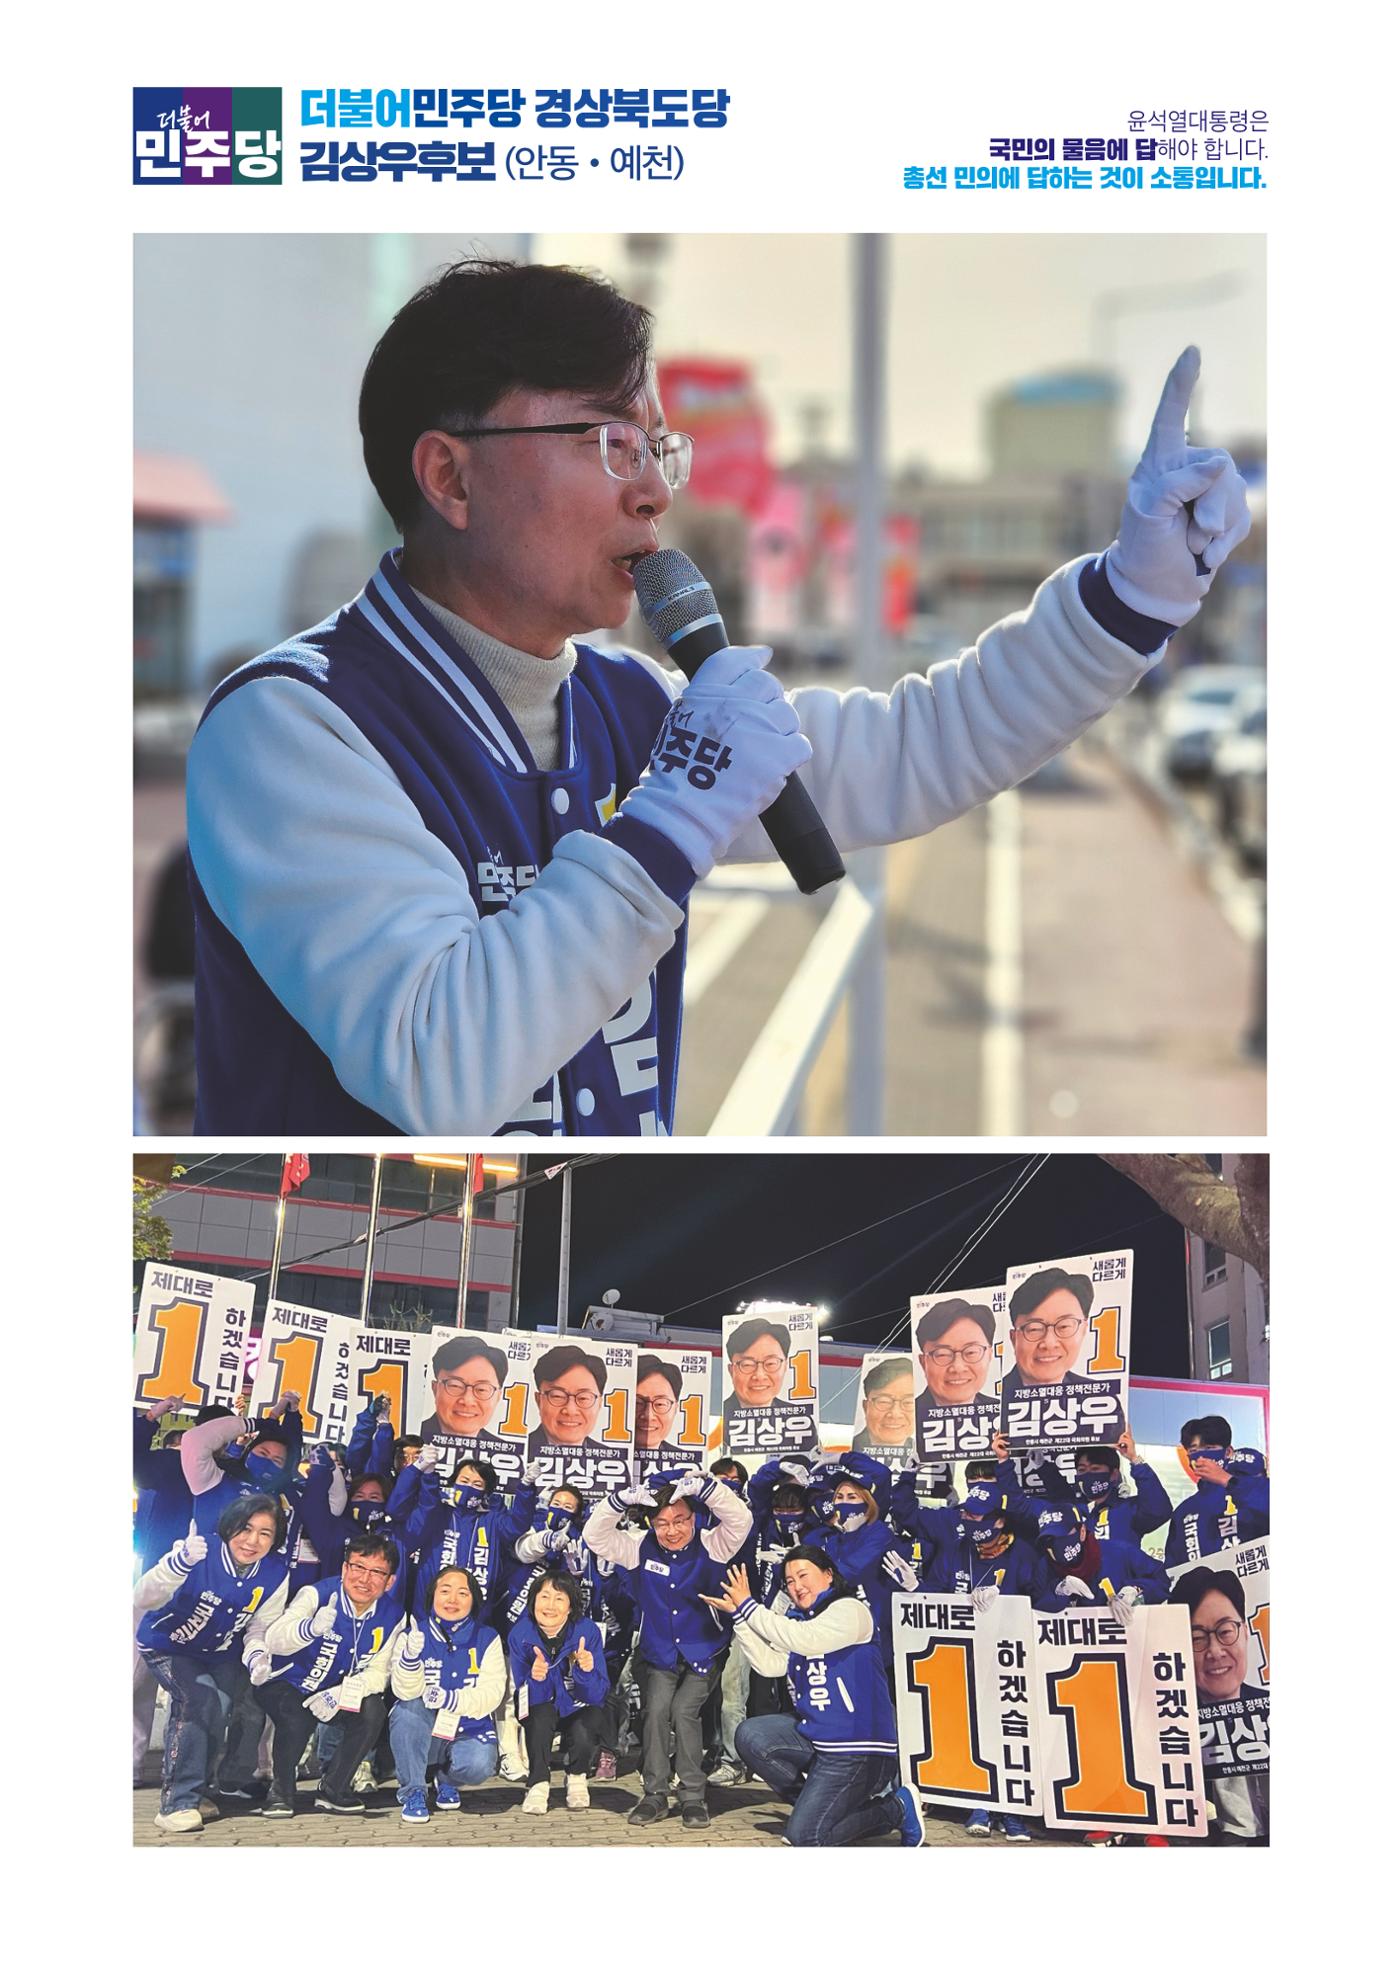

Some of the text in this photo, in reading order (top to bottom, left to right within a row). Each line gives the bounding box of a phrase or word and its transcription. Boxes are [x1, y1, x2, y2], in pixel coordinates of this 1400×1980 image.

[151, 1271, 214, 1298] 제대로
[1092, 1257, 1127, 1271] 새롭게
[1092, 1269, 1127, 1282] 다르게
[272, 1307, 328, 1333] 제대로
[1087, 1306, 1127, 1375] 1
[135, 1296, 210, 1408] 1
[356, 1335, 411, 1356] 제대로
[605, 1357, 633, 1367] 다르게
[257, 1331, 324, 1439] 1
[788, 1350, 817, 1401] 1
[1014, 1382, 1111, 1399] 지방소멸대응 정책전문가
[358, 1358, 409, 1440] 1
[498, 1382, 530, 1438] 1
[602, 1388, 633, 1443] 1
[677, 1394, 707, 1446] 1
[1007, 1395, 1119, 1438] 김상우
[728, 1416, 813, 1448] 김상우
[534, 1456, 626, 1491] 김상우
[1234, 1544, 1268, 1564] 새롭게
[1236, 1558, 1270, 1578] 다르게
[900, 1603, 976, 1631] 제대로
[1036, 1617, 1128, 1647] 제대로
[467, 1647, 480, 1675] 1
[805, 1653, 832, 1712] 상우
[906, 1637, 1000, 1803] 1
[997, 1640, 1036, 1807] 하겠습니다
[1046, 1653, 1160, 1826] 1
[1153, 1652, 1200, 1828] 하겠습니다
[1199, 1712, 1270, 1765] 김상
